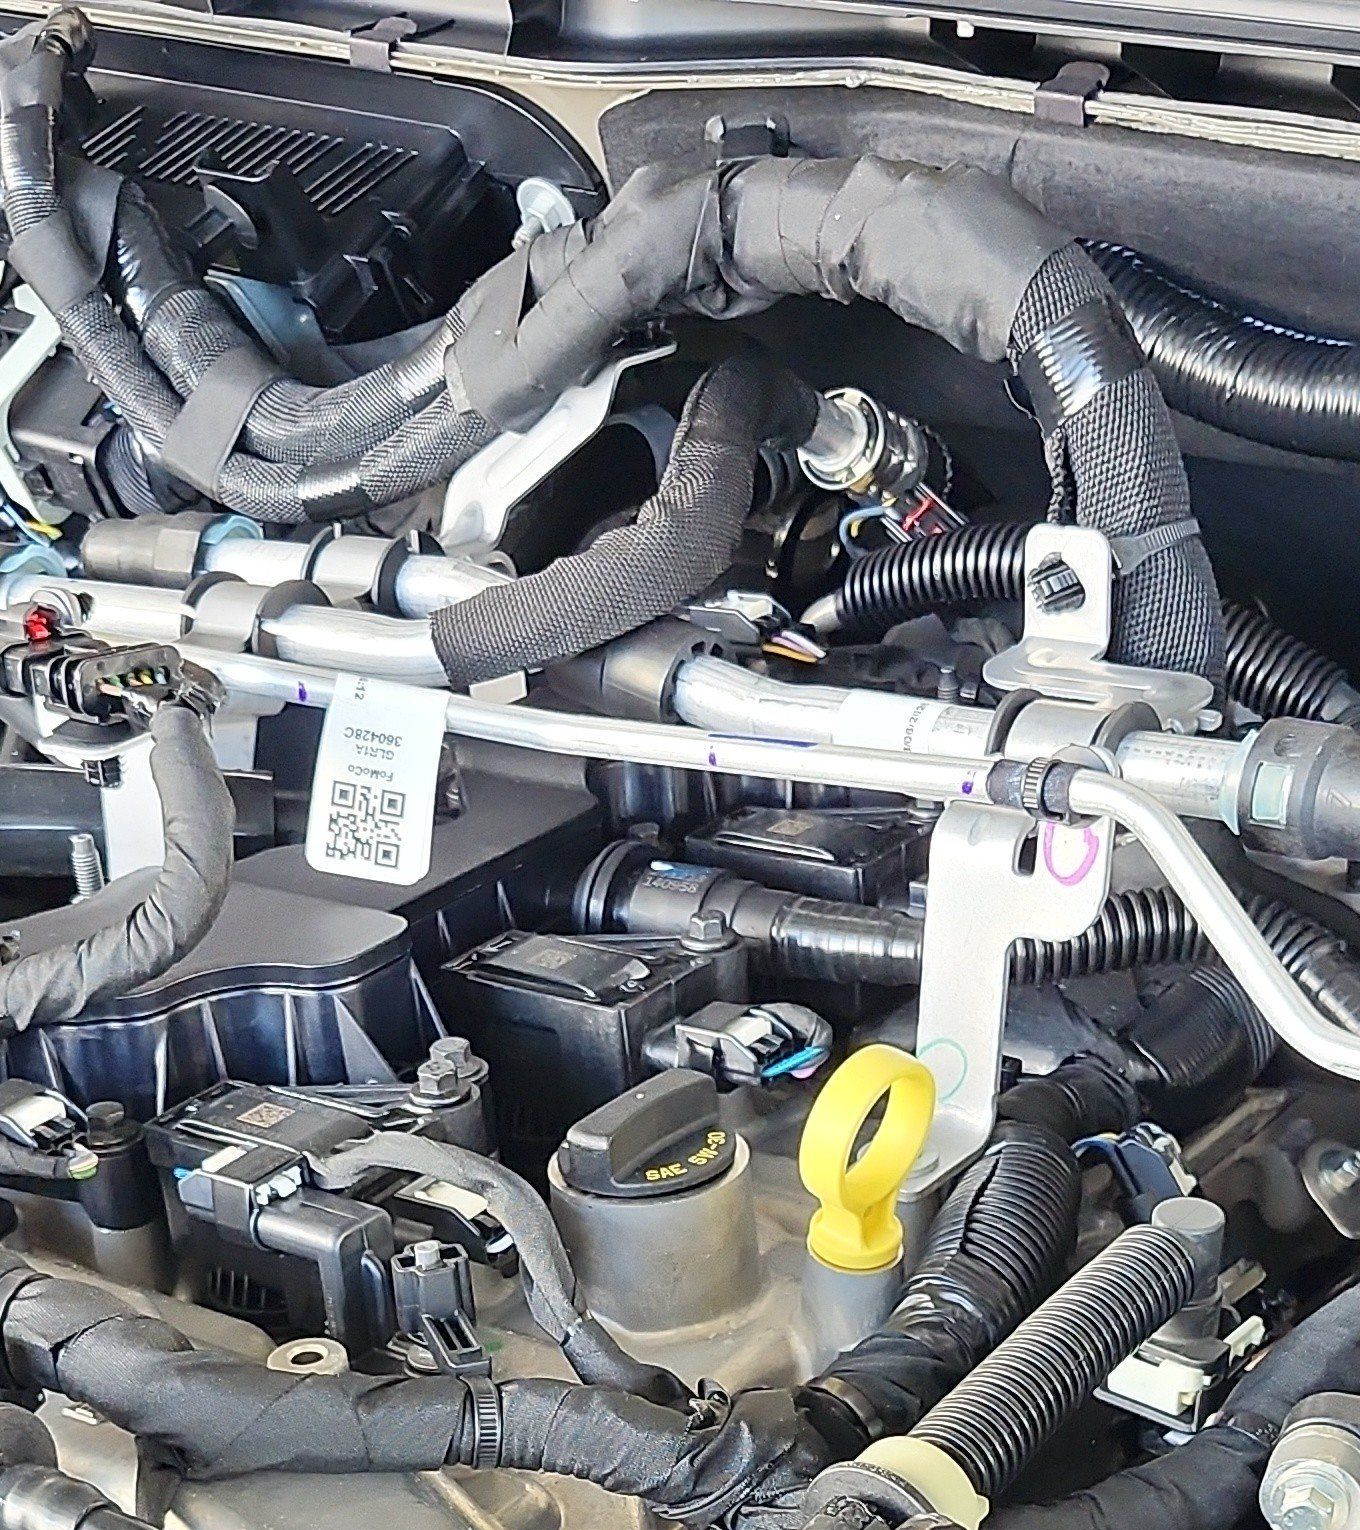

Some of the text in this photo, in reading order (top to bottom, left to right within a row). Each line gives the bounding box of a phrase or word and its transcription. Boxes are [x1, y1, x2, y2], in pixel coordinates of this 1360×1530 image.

[343, 727, 403, 747] 360428C
[348, 764, 394, 782] FoMoCo
[645, 1163, 688, 1181] SAE
